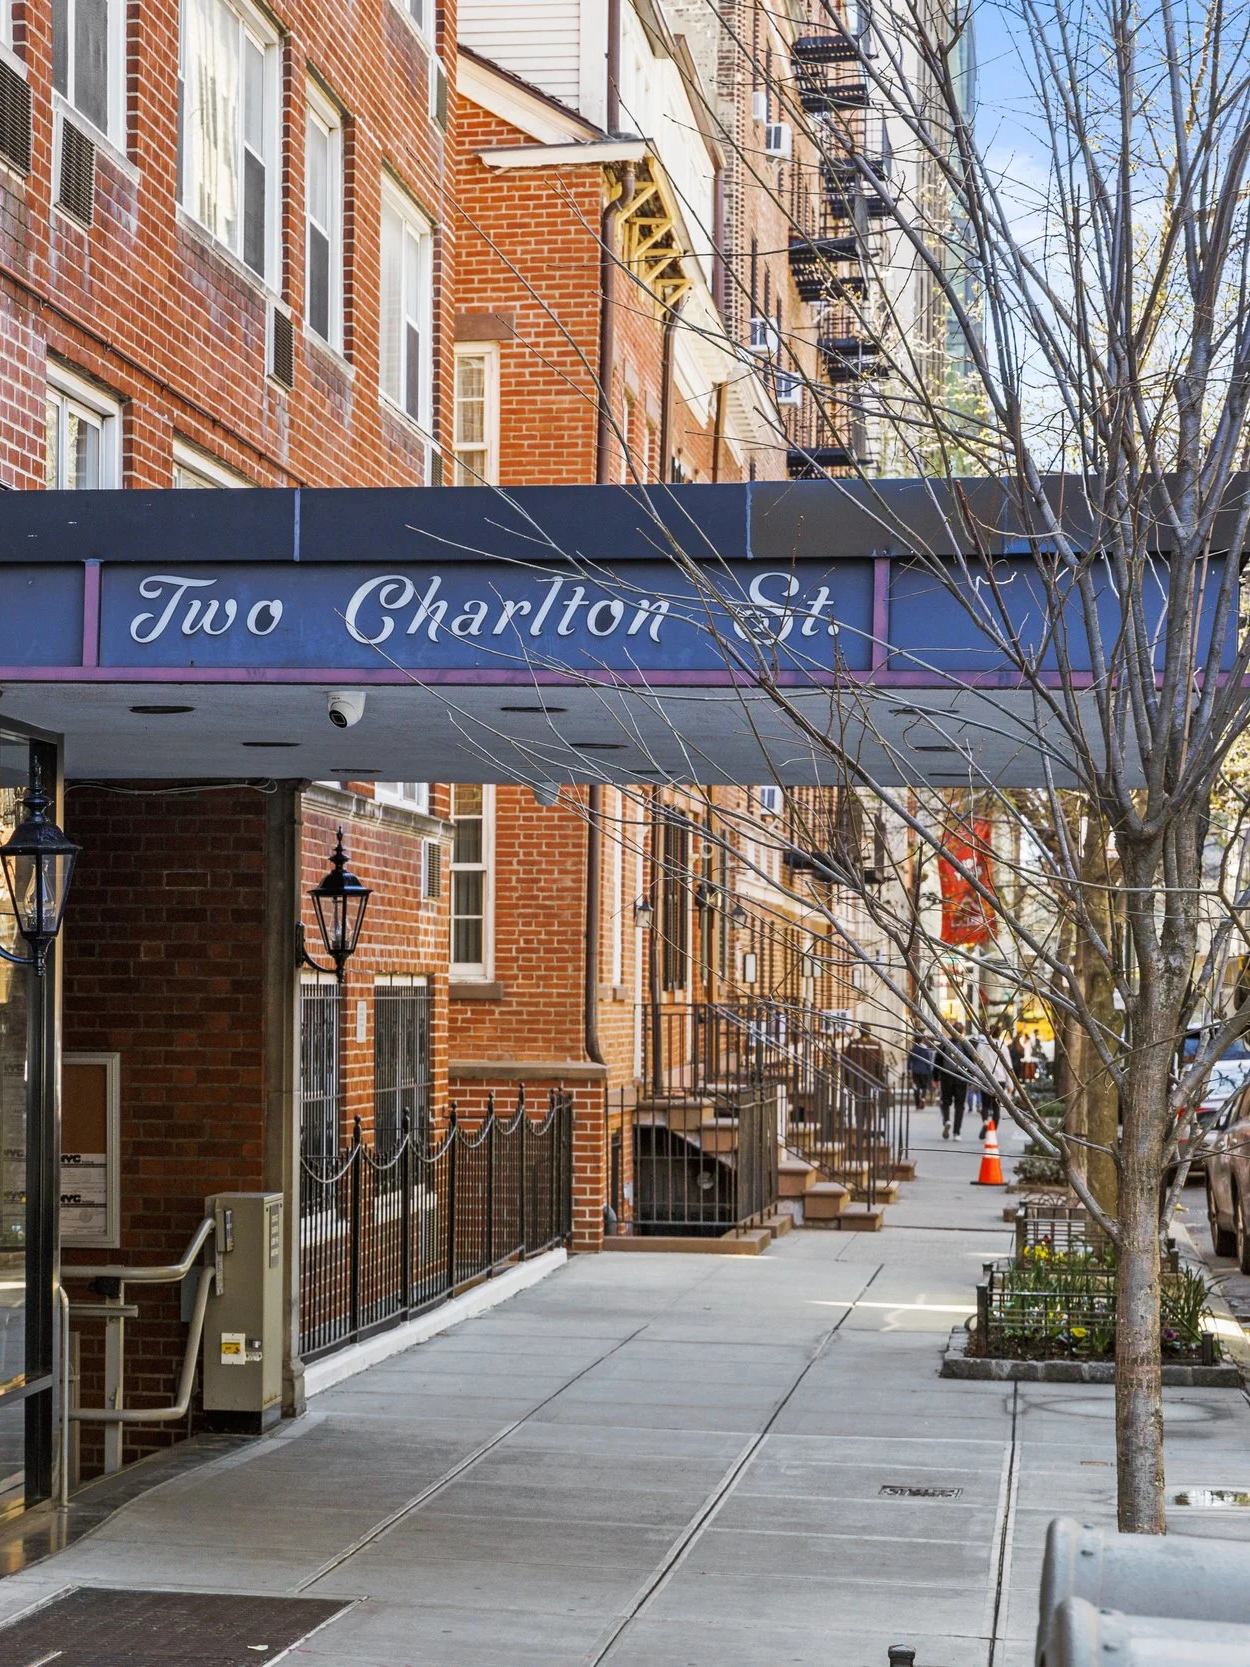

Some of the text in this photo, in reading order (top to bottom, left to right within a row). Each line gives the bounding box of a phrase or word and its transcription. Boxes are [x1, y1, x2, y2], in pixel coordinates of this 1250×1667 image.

[130, 572, 840, 647] Two Charlton St.
